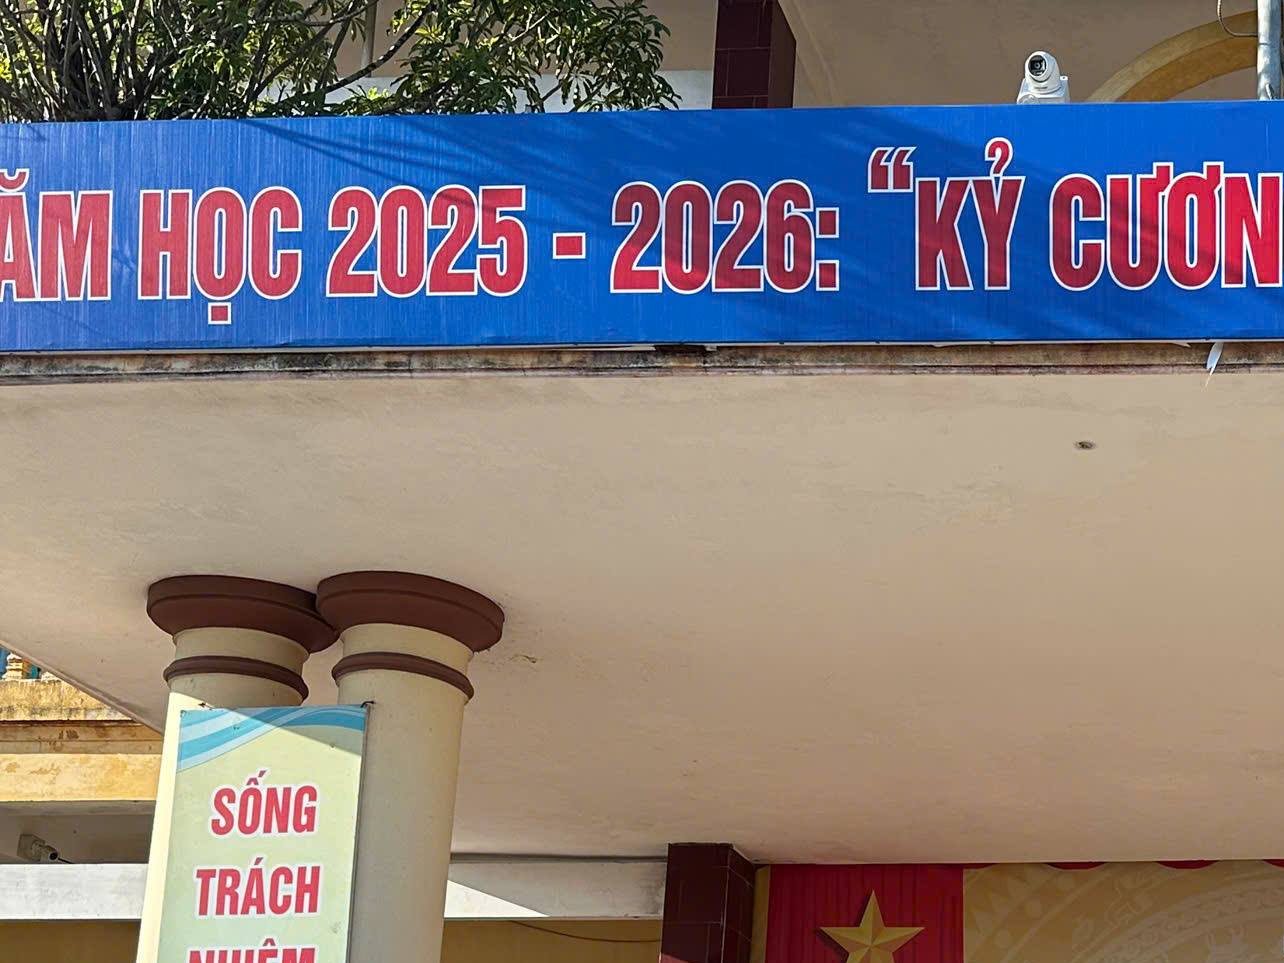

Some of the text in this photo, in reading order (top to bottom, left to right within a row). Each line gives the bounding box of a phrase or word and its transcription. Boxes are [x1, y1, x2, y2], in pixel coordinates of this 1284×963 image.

[138, 187, 303, 326] HỌC
[326, 184, 528, 299] 2025
[552, 232, 587, 260] -
[609, 180, 841, 295] 2026:
[210, 769, 318, 836] SỐNG
[196, 857, 321, 917] TRÁCH
